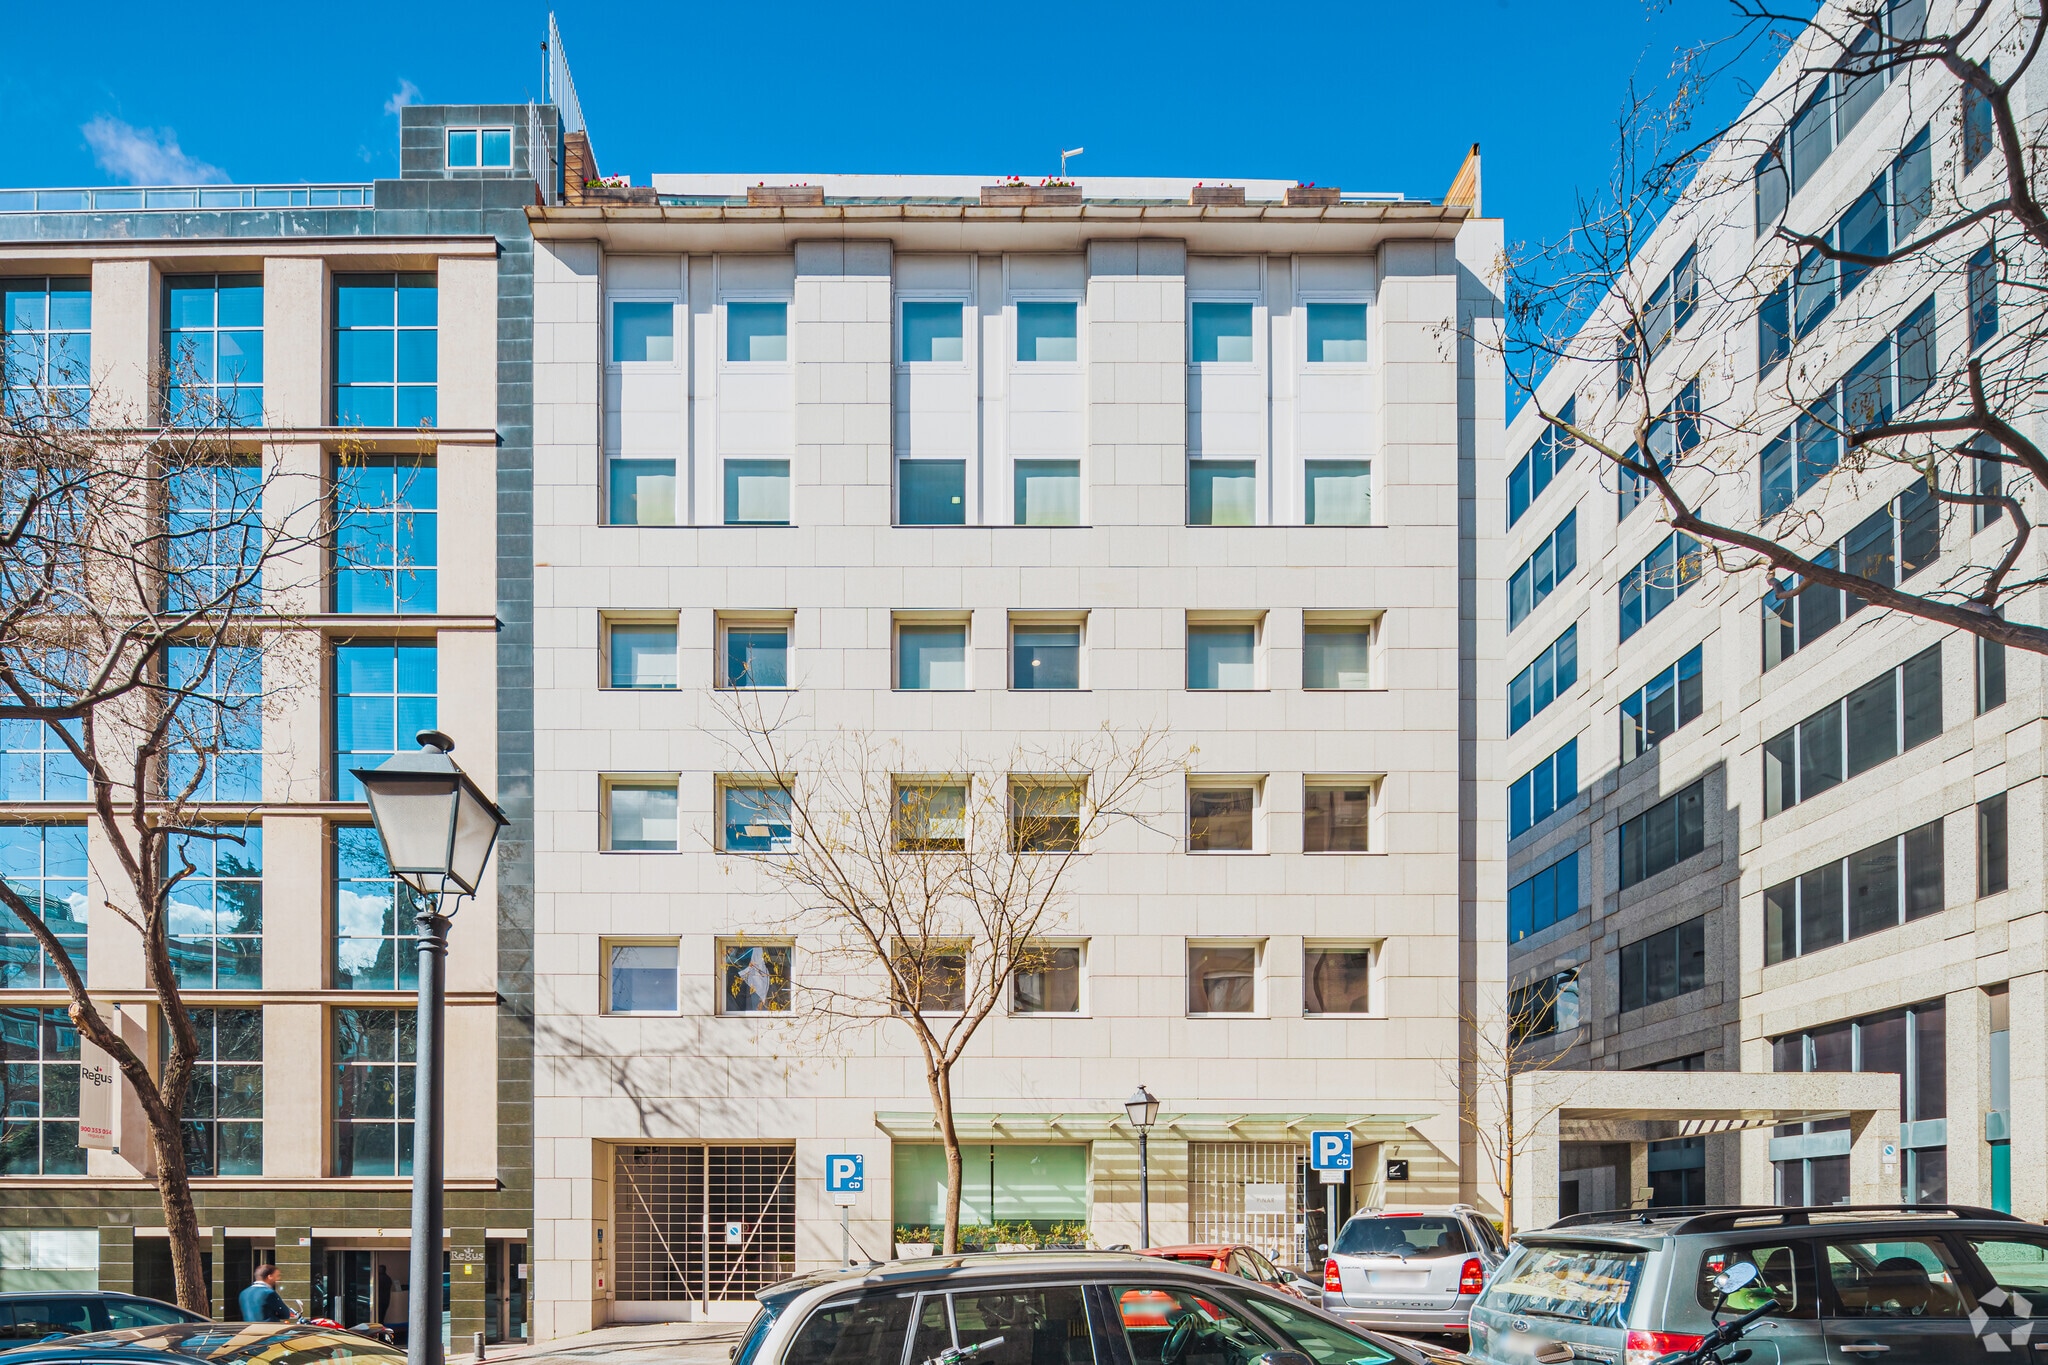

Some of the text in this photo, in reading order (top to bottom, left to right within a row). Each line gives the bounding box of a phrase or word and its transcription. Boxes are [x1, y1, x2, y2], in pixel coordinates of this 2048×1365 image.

[82, 1067, 112, 1086] Regus
[1319, 1136, 1344, 1166] P
[1393, 1145, 1401, 1156] 7
[856, 1155, 862, 1163] 2
[1336, 1158, 1349, 1166] CD
[833, 1158, 856, 1188] P
[848, 1181, 861, 1189] CD
[451, 1250, 484, 1261] Regus
